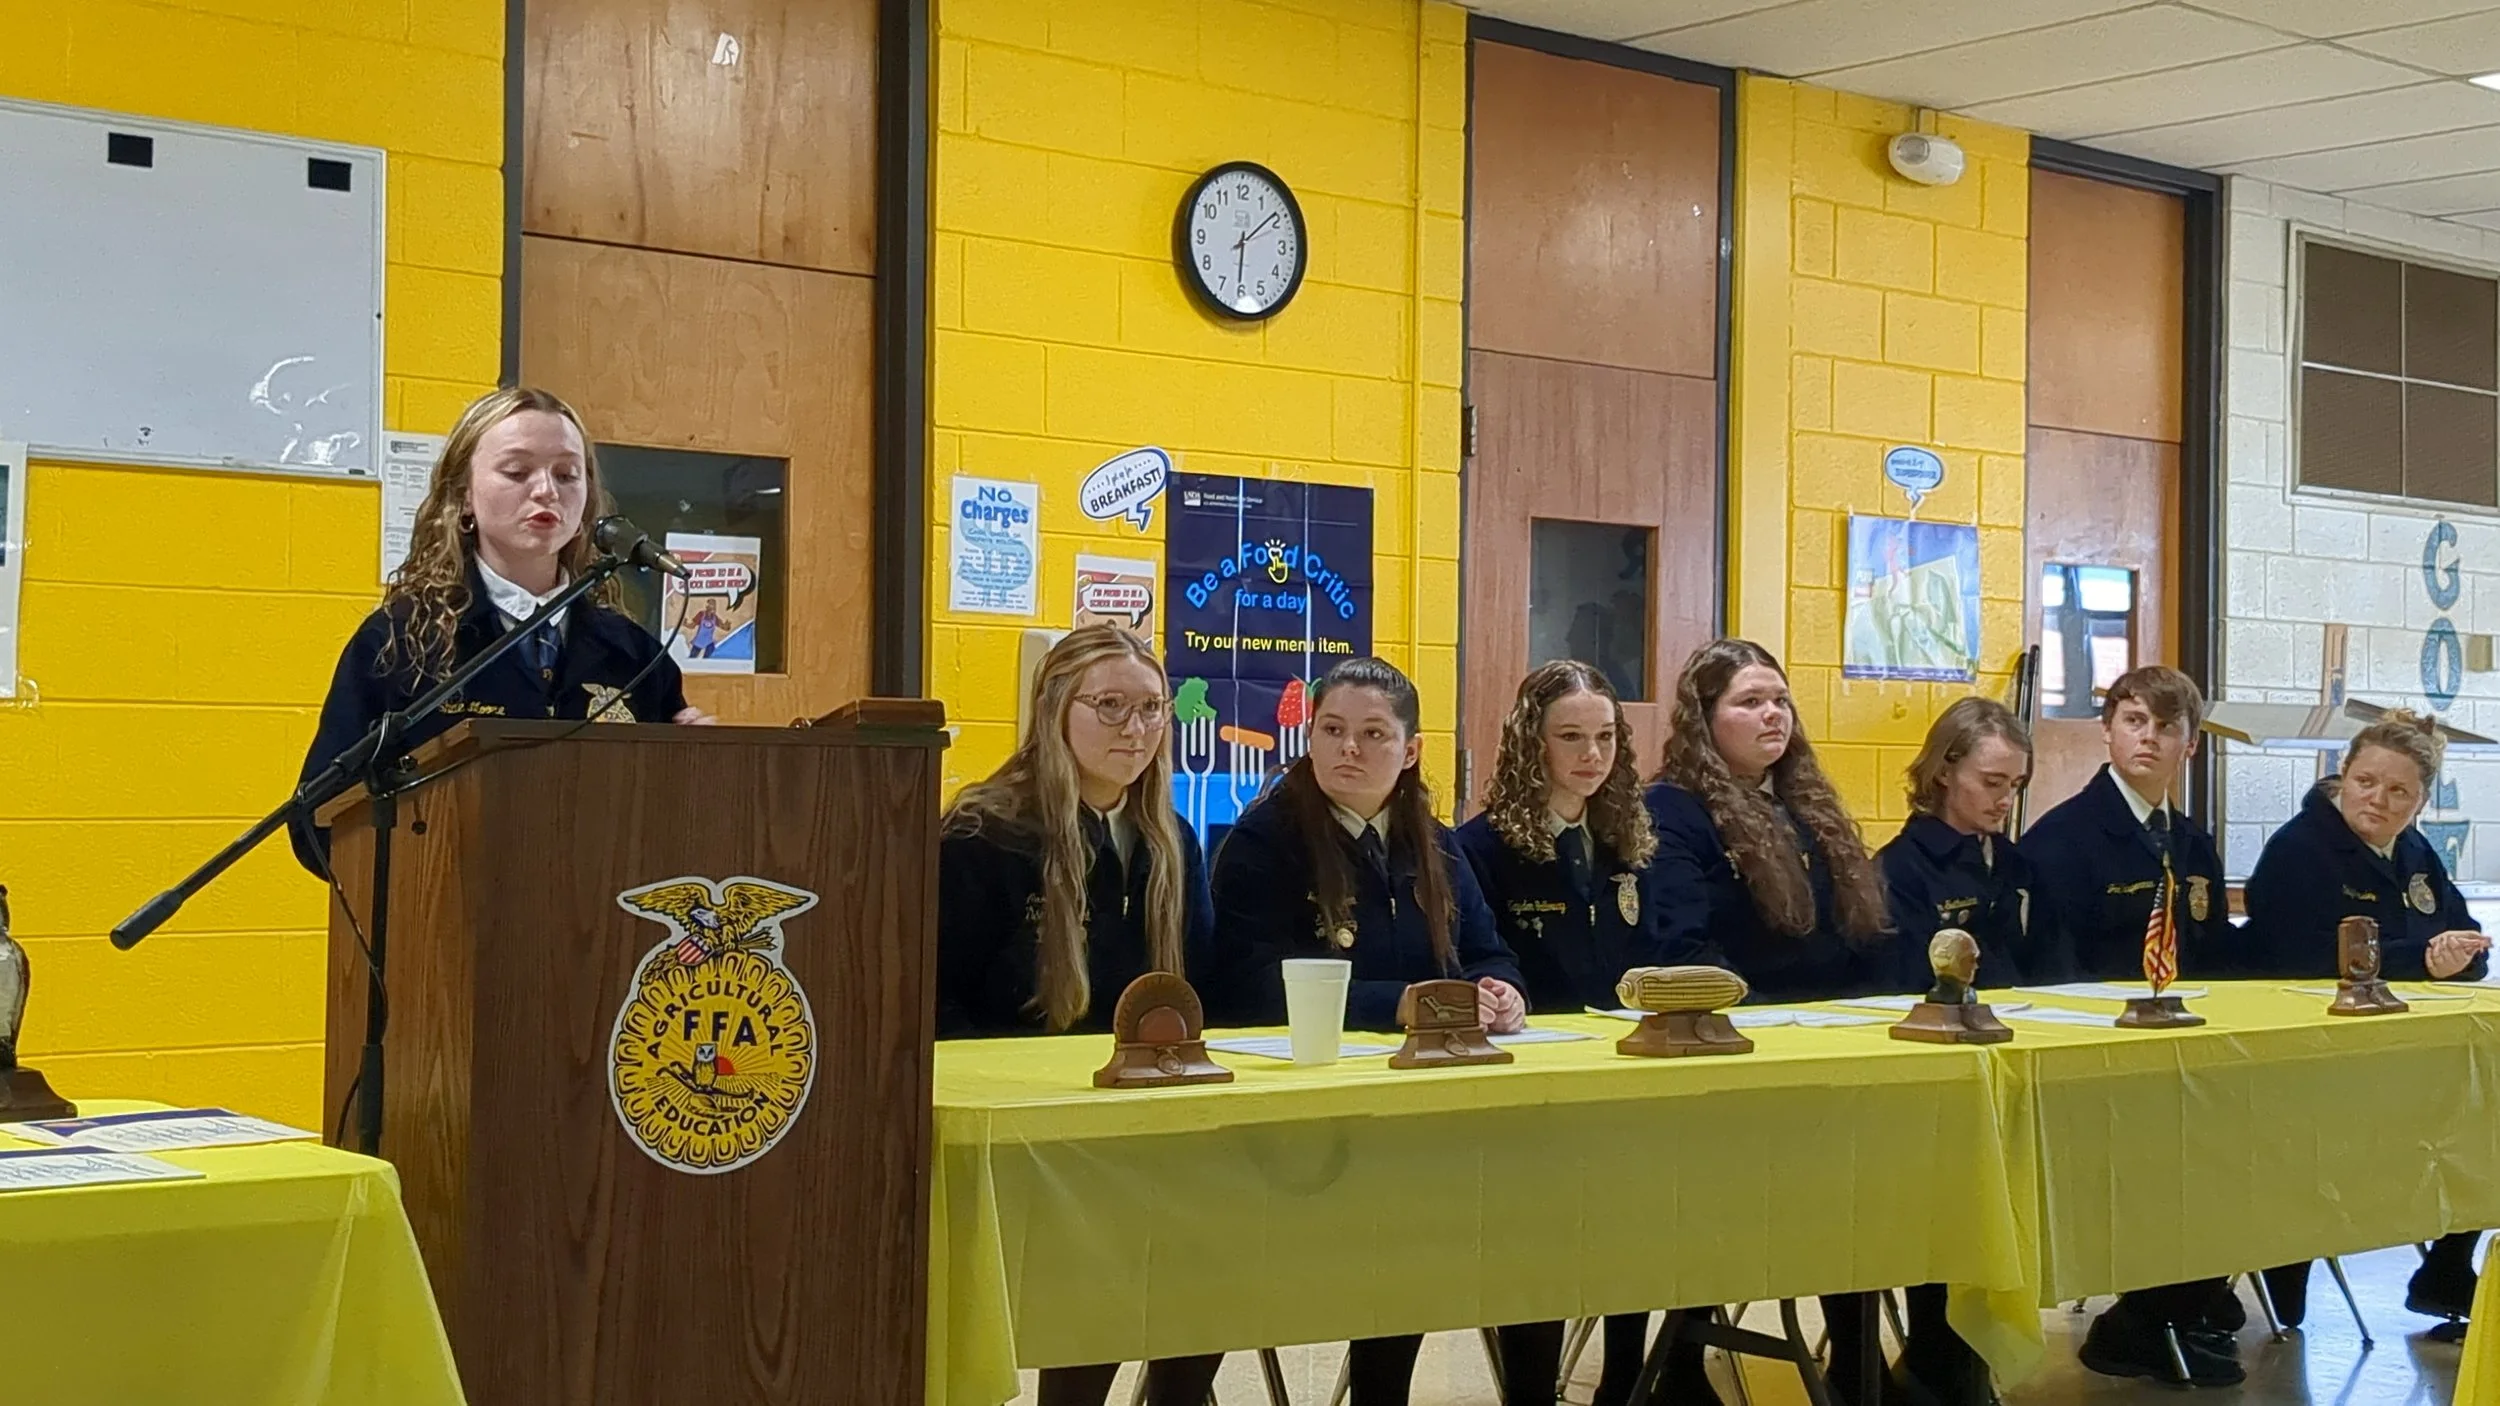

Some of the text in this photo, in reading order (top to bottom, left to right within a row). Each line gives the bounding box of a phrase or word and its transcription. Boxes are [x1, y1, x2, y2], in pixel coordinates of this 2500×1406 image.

[1216, 190, 1228, 205] 11
[1236, 185, 1250, 200] 12
[1203, 203, 1217, 219] 10
[1258, 196, 1264, 210] 1
[1272, 213, 1281, 229] 2
[1196, 229, 1205, 244] 9
[1277, 240, 1286, 255] 3
[1202, 255, 1211, 270] 8
[1271, 264, 1279, 278] 4
[1218, 276, 1226, 290] 7
[1237, 285, 1246, 297] 6
[1256, 280, 1265, 295] 5
[978, 486, 1012, 502] NO
[1090, 467, 1162, 513] BREAKFAST!
[960, 500, 1029, 528] Charges
[1186, 572, 1219, 608] Be
[1220, 558, 1237, 578] a
[1305, 554, 1354, 618] Critic
[1235, 589, 1307, 614] for a day
[1185, 631, 1354, 654] Try our new menu item.
[645, 977, 785, 1060] AGRICULTURAL
[683, 1010, 759, 1047] FFA
[652, 1090, 772, 1136] EDUCATION
